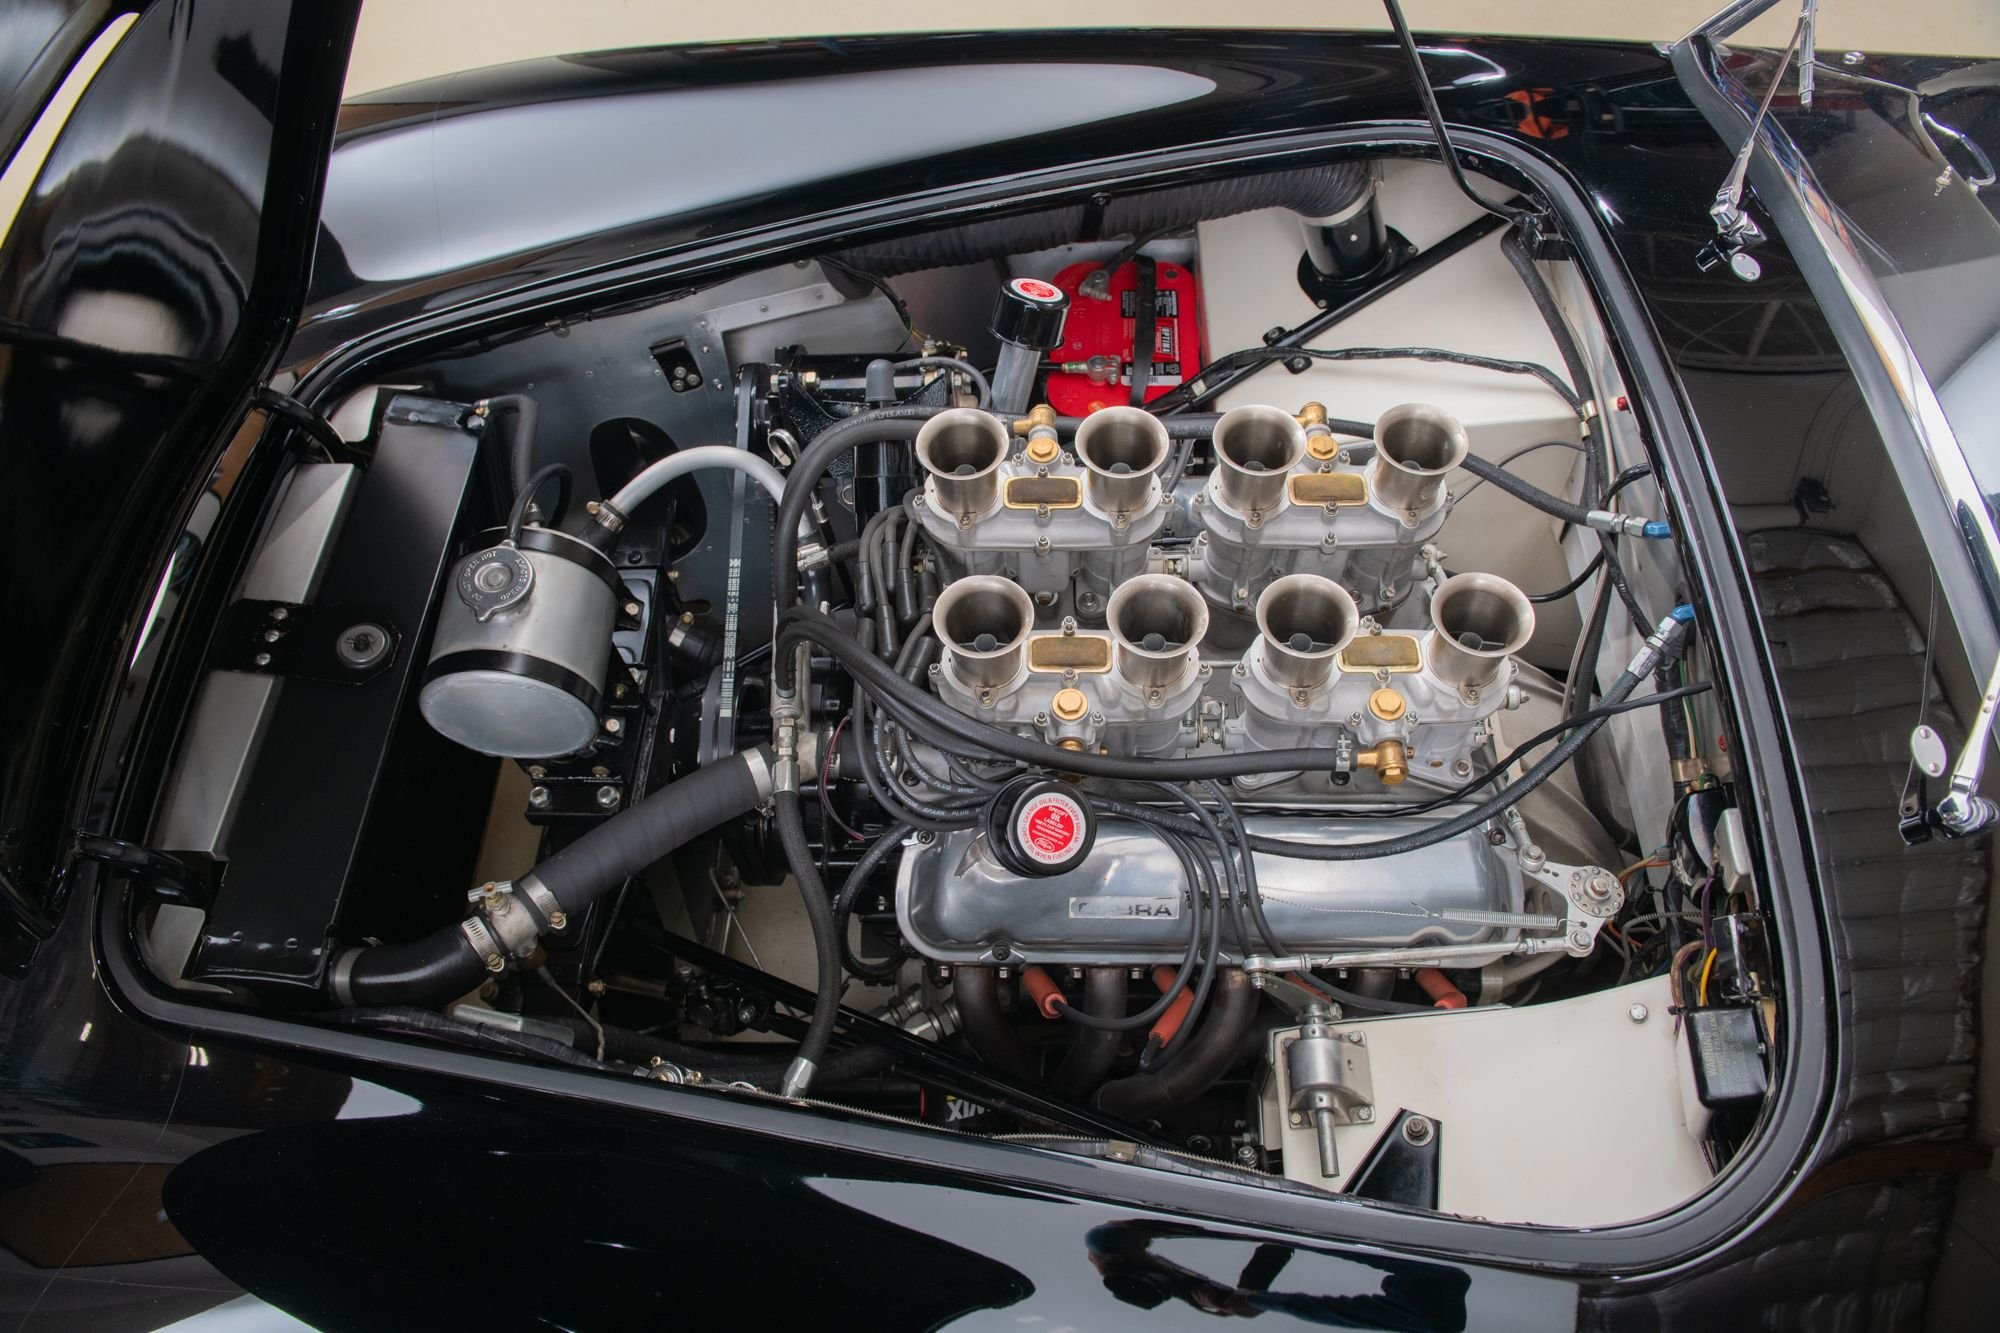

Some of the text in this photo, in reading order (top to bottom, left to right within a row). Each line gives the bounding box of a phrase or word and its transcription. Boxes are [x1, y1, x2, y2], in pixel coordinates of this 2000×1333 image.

[1161, 327, 1171, 353] OPTIMA
[462, 550, 497, 601] DO NOT OPEN HOT
[500, 585, 522, 601] OPEN
[874, 751, 887, 774] SUPER
[886, 777, 919, 808] CONDUCTOR
[922, 806, 945, 816] SPARK
[951, 809, 970, 817] PLUG
[911, 762, 930, 781] SPARK
[933, 780, 953, 792] PLUG
[1023, 803, 1038, 824] CHANGE
[1068, 805, 1079, 821] EVERY
[1043, 817, 1064, 829] LABELED
[1050, 813, 1061, 822] OIL
[1022, 827, 1030, 845] CHECK
[1034, 851, 1052, 860] WHEN
[1052, 847, 1073, 860] FUELING
[1702, 1032, 1718, 1077] WARNING
